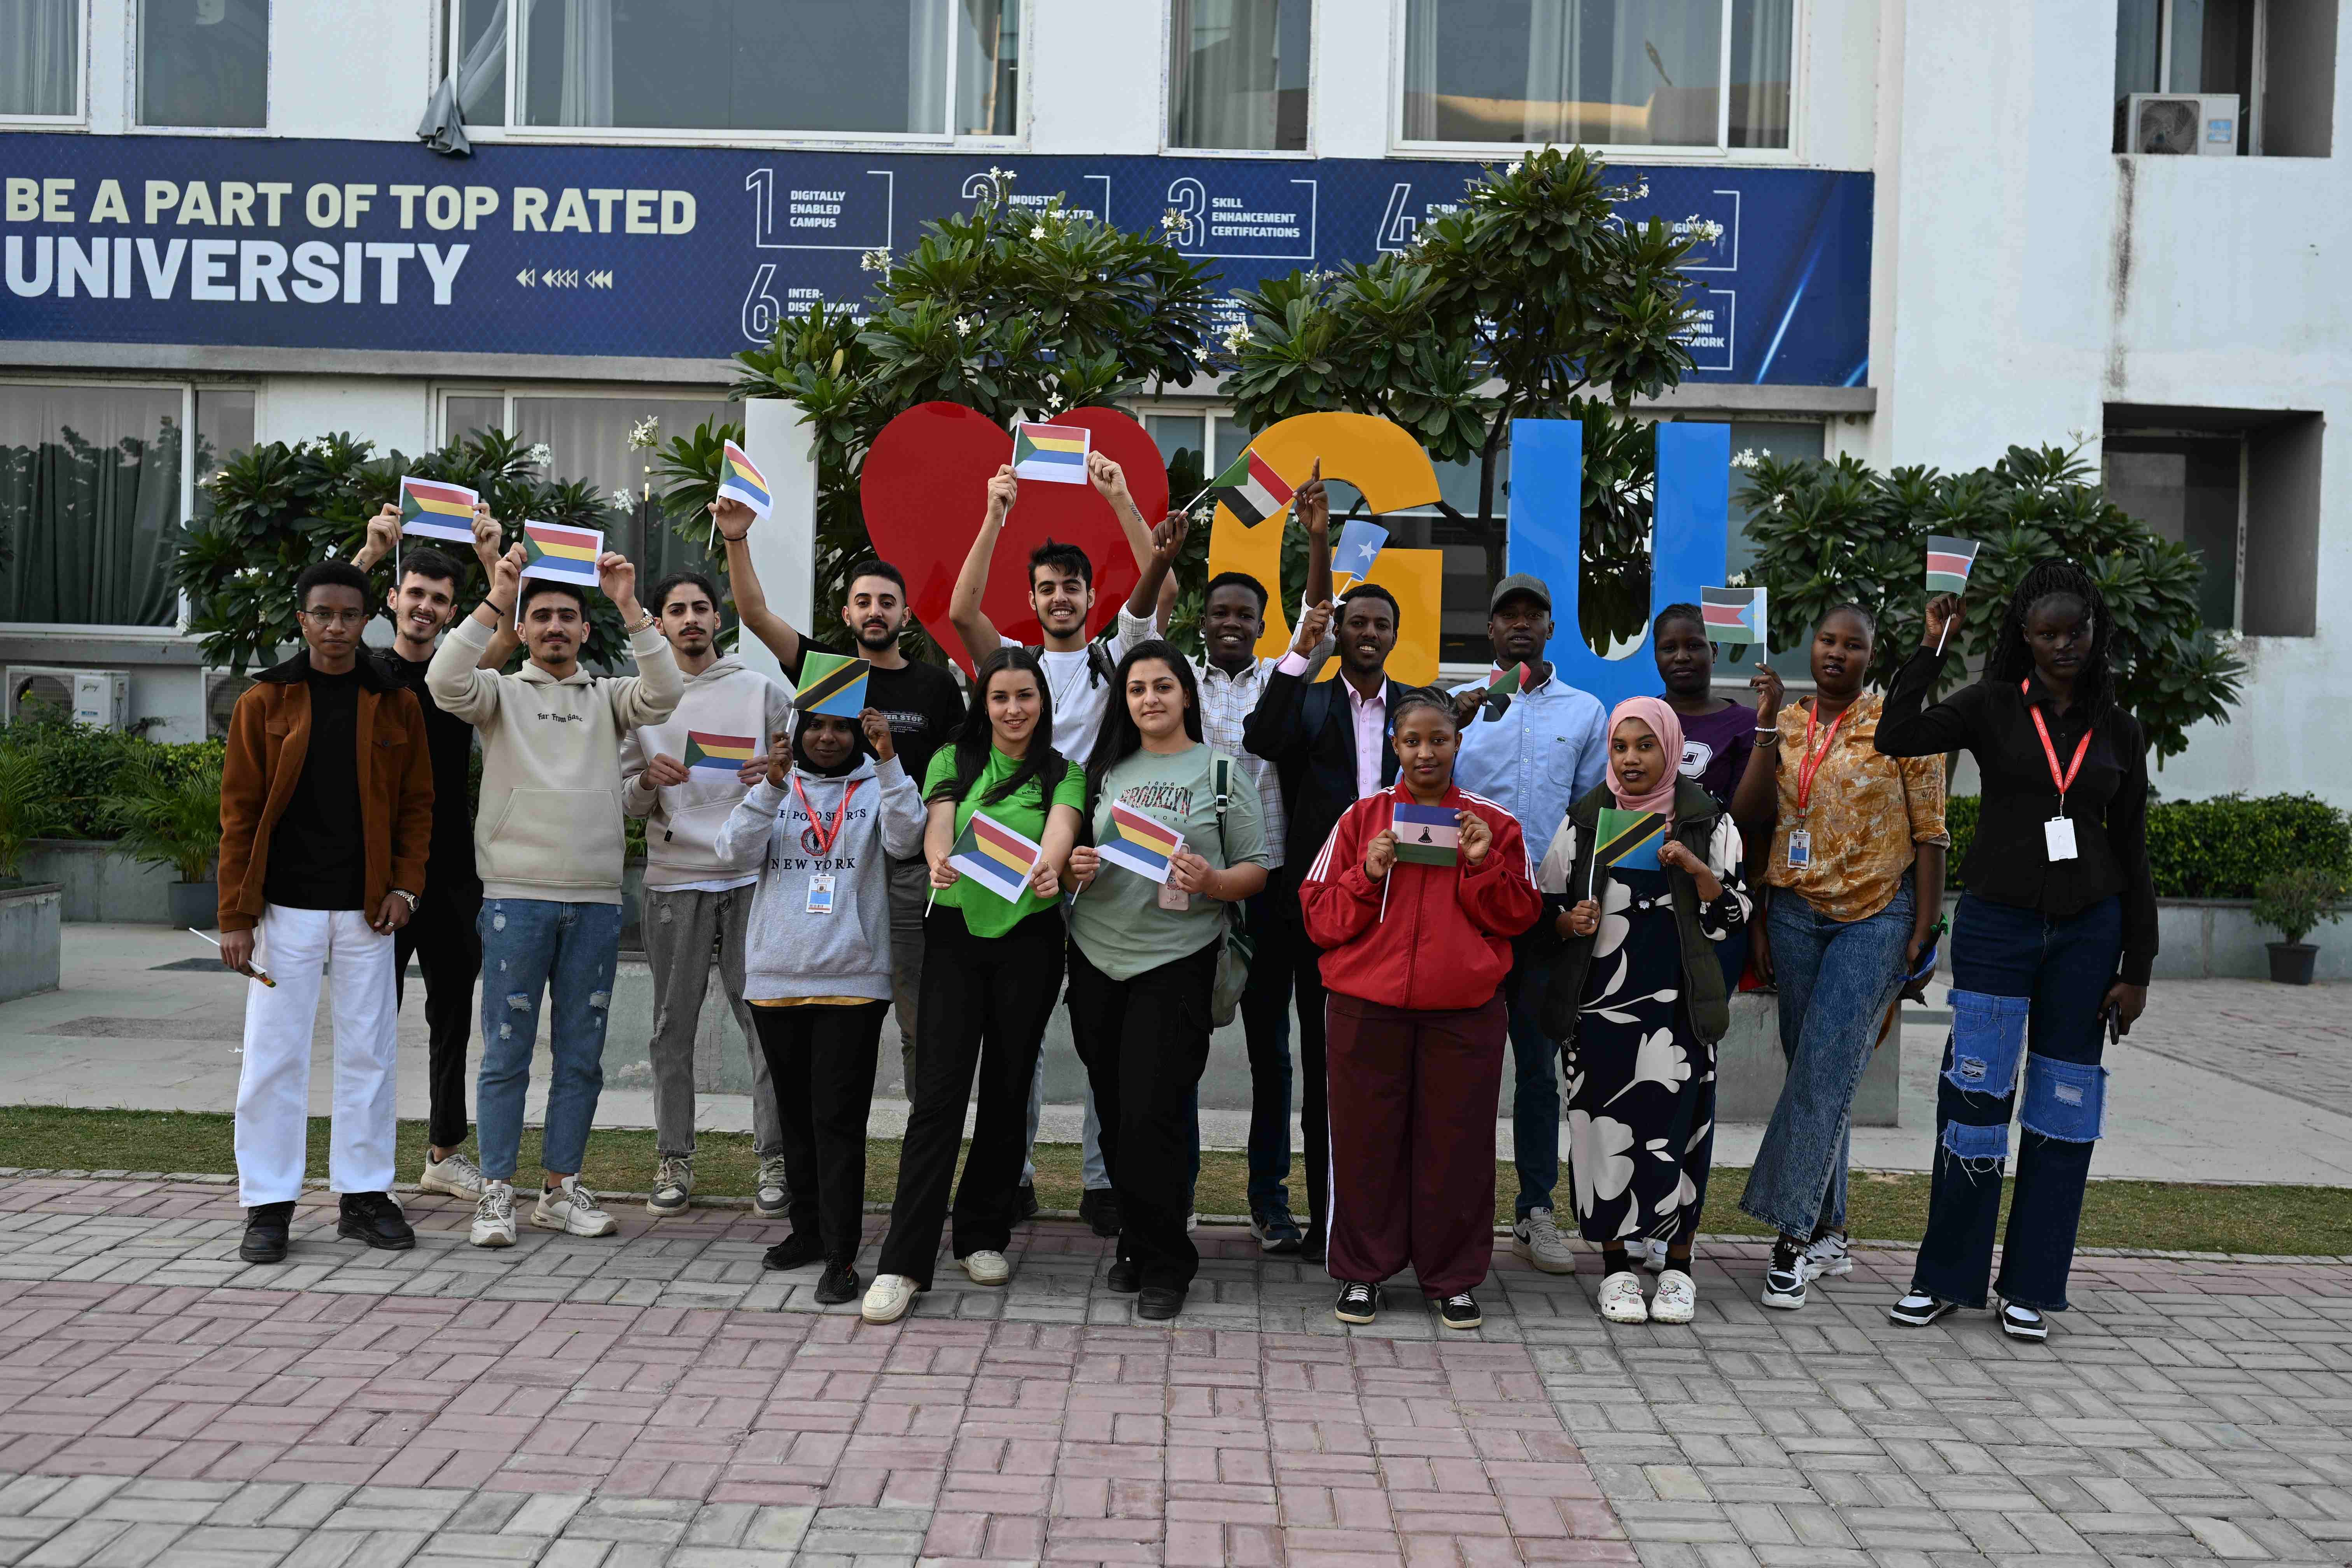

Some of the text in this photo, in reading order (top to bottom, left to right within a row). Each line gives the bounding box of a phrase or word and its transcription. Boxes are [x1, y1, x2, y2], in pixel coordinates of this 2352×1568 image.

[791, 190, 845, 201] DIGITALLY
[1008, 195, 1062, 206] INDUST
[6, 178, 696, 234] BE A PART OF TOP RATED
[1212, 198, 1243, 208] SKILL
[790, 204, 841, 214] ENABLED
[790, 217, 836, 228] CAMPUS
[1212, 212, 1296, 223] ENHANCEMENT
[1211, 226, 1300, 237] CERTIFICATIONS
[5, 236, 470, 304] UNIVERSITY
[788, 288, 824, 299] INTER-
[551, 713, 567, 723] From
[792, 810, 822, 821] POO
[825, 808, 866, 821] SRTS
[831, 811, 842, 834] UNIVERSITY
[771, 857, 856, 871] NEW YORK
